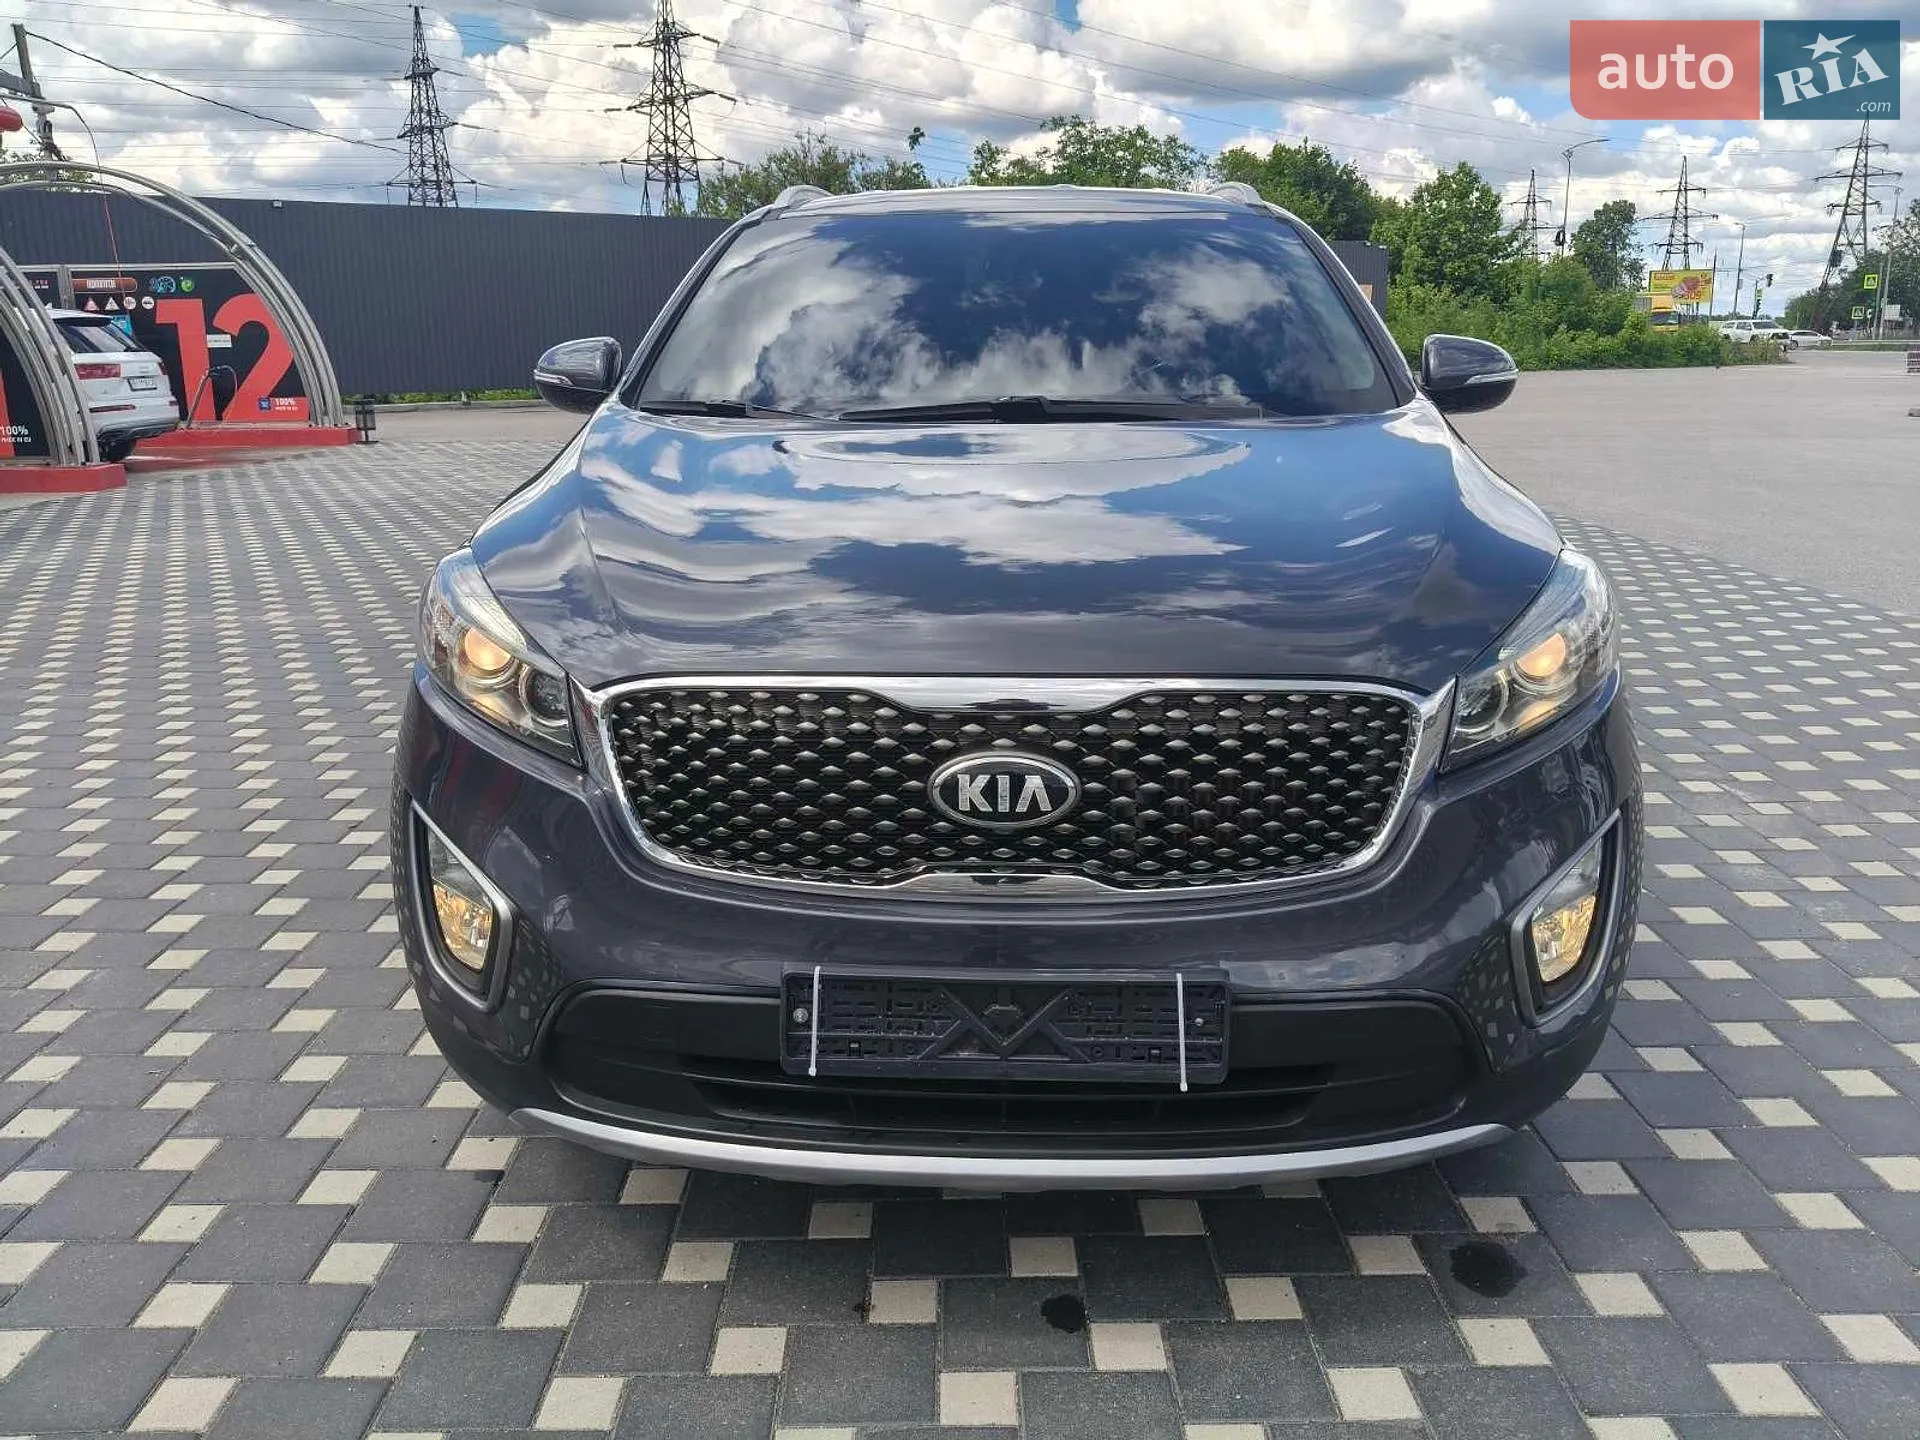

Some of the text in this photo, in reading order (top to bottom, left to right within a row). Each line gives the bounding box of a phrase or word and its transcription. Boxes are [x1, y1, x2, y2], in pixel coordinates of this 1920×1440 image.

[156, 293, 311, 421] 12
[0, 424, 29, 436] 100%
[957, 774, 1053, 813] KIA
